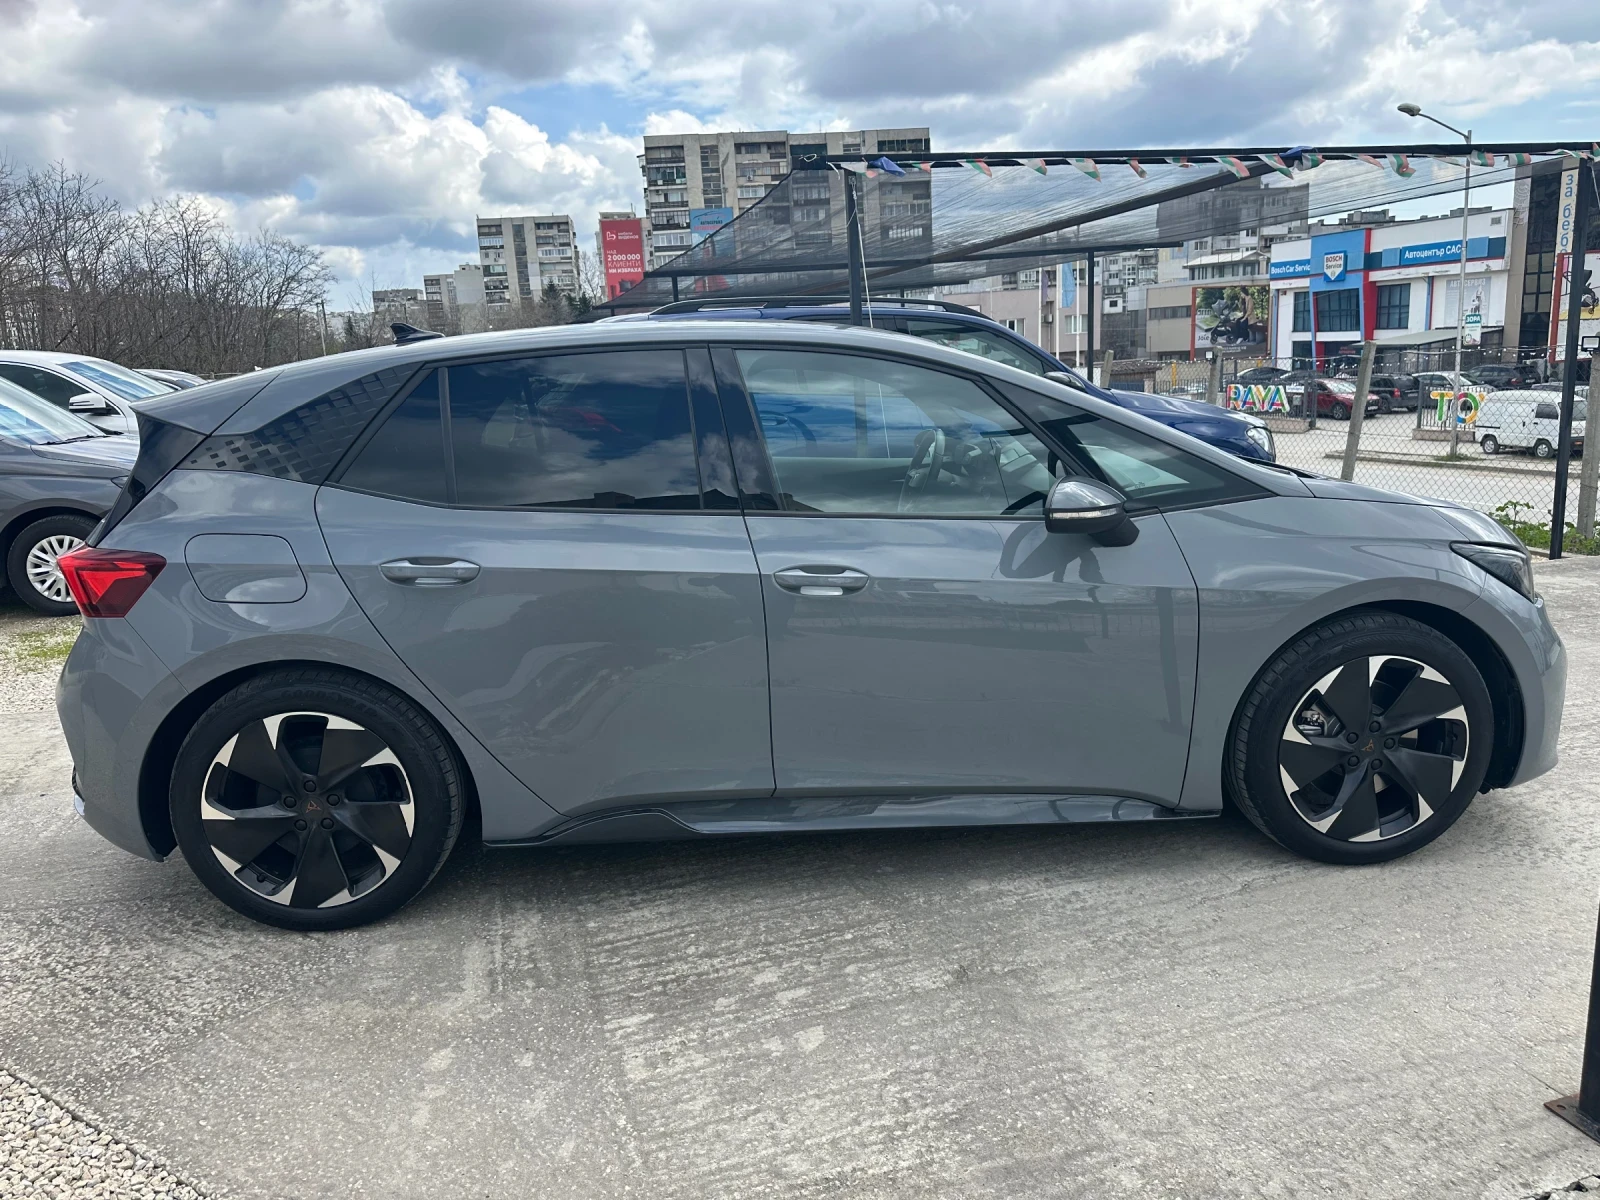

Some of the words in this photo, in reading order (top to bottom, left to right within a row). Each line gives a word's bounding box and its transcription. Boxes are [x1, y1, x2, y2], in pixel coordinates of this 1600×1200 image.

[1560, 203, 1572, 253] беб
[1404, 248, 1445, 259] Автоцентър
[1325, 255, 1342, 263] BOSCH
[1271, 265, 1286, 274] Bosch
[1286, 264, 1295, 273] Car
[1450, 278, 1486, 288] АВТСЕРВИЗ
[1466, 315, 1481, 323] ЗОРА
[1227, 384, 1290, 413] RAYA
